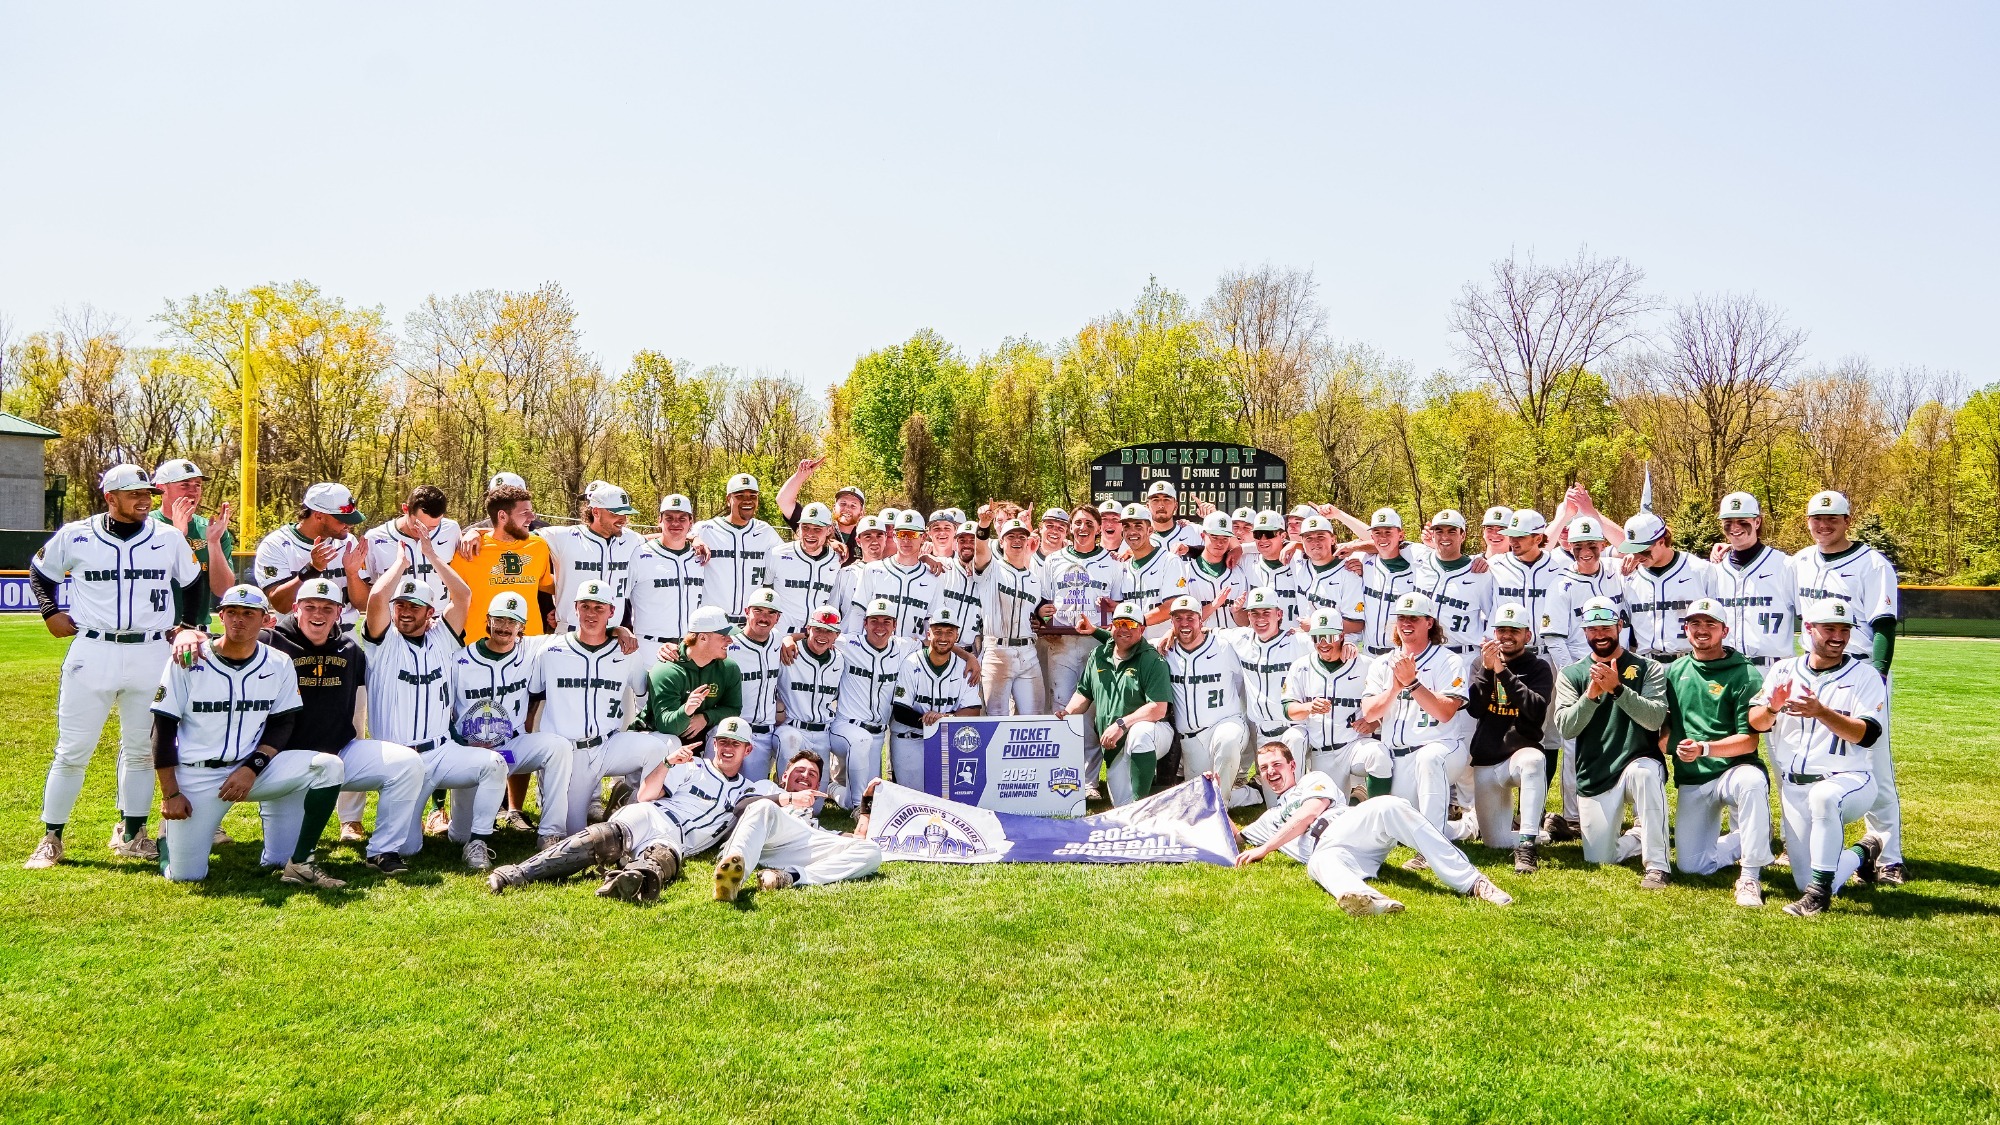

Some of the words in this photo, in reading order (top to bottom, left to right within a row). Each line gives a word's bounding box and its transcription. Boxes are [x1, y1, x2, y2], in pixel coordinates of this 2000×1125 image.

[1121, 448, 1257, 465] BROCKPORT
[1141, 467, 1149, 480] 0
[1152, 469, 1171, 478] BALL
[1182, 467, 1190, 480] 0
[1192, 469, 1220, 478] STRIKE
[1231, 467, 1240, 480] 0
[1242, 469, 1257, 478] OUT
[1094, 492, 1114, 501] SAGE
[1264, 492, 1271, 503] 3
[502, 552, 522, 575] B
[84, 569, 167, 582] BROCKPORT
[489, 577, 537, 585] BASEBALL
[1450, 615, 1471, 633] 37
[1757, 613, 1784, 635] 47
[556, 677, 623, 692] BROCKPORT
[1207, 688, 1225, 709] 21
[1009, 728, 1052, 740] TICKET
[1002, 744, 1060, 757] PUNCHED
[1001, 769, 1037, 781] 2025
[999, 790, 1038, 798] CHAMPIONS
[951, 817, 981, 844] LEADERS
[1064, 834, 1181, 850] BASEBALL
[1052, 847, 1200, 857] CHAMPIONS
